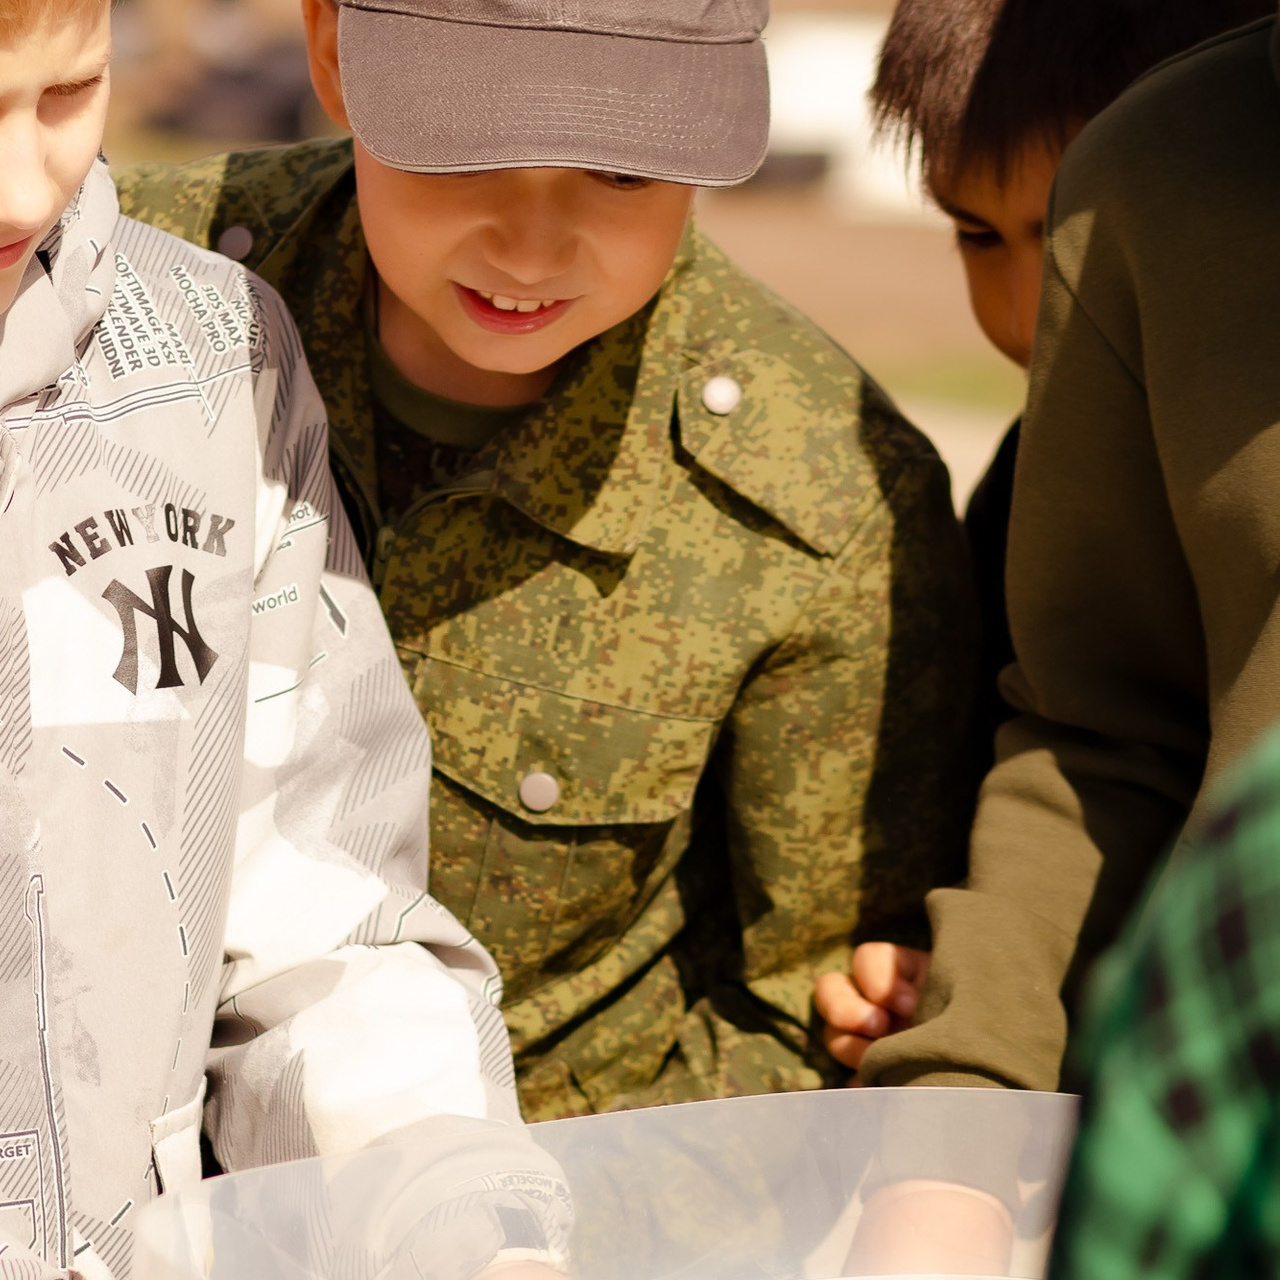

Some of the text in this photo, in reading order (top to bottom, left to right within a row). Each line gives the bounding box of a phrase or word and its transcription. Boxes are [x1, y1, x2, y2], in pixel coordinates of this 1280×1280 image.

[171, 266, 226, 353] MOCHA PRO
[201, 285, 245, 347] 3DS MAX
[165, 322, 192, 365] MARI
[47, 503, 237, 576] NEW YORK
[252, 586, 299, 614] world
